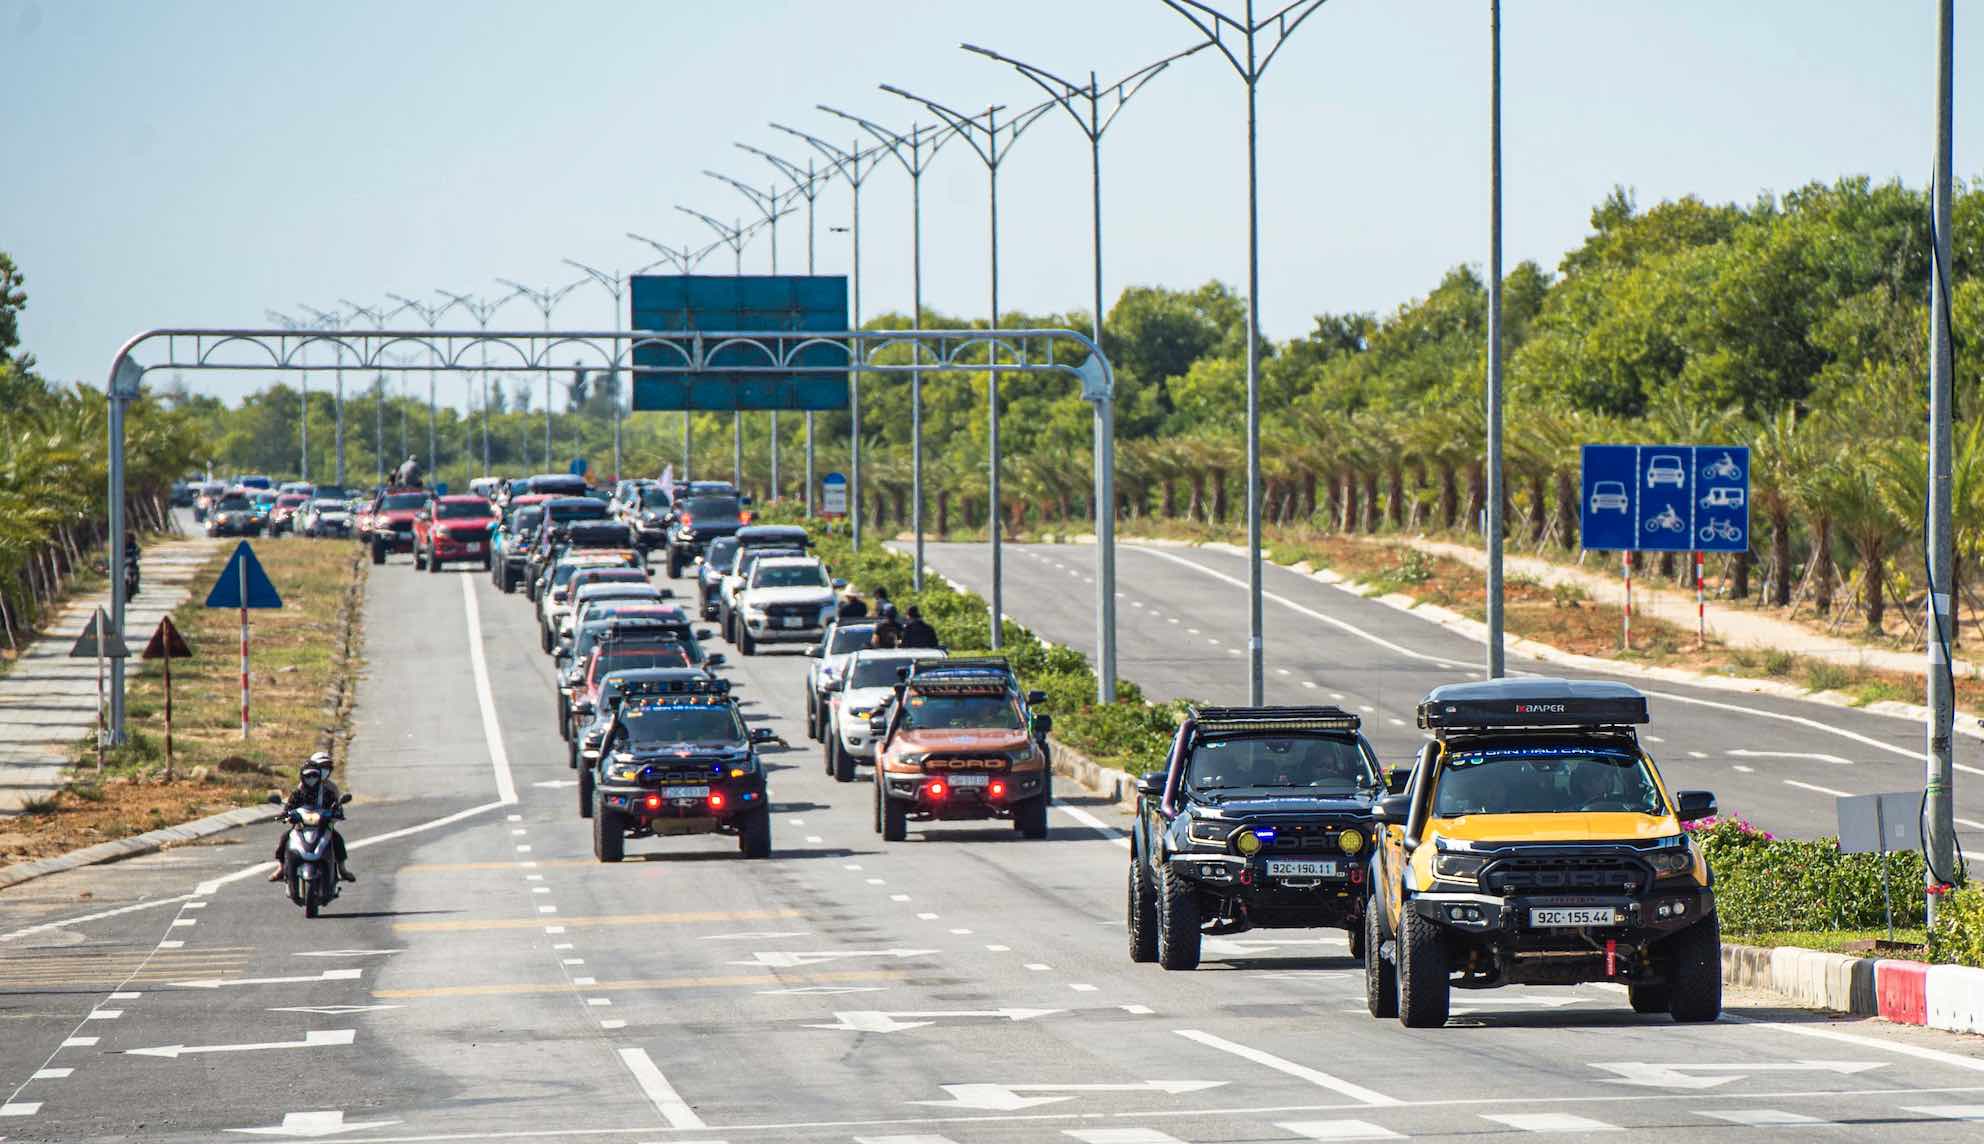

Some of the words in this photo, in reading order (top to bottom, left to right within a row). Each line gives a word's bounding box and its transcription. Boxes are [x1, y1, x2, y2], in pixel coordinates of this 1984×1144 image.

[928, 759, 1006, 769] FORD
[1504, 870, 1634, 888] FORD
[1538, 911, 1608, 924] 92C-155.44
